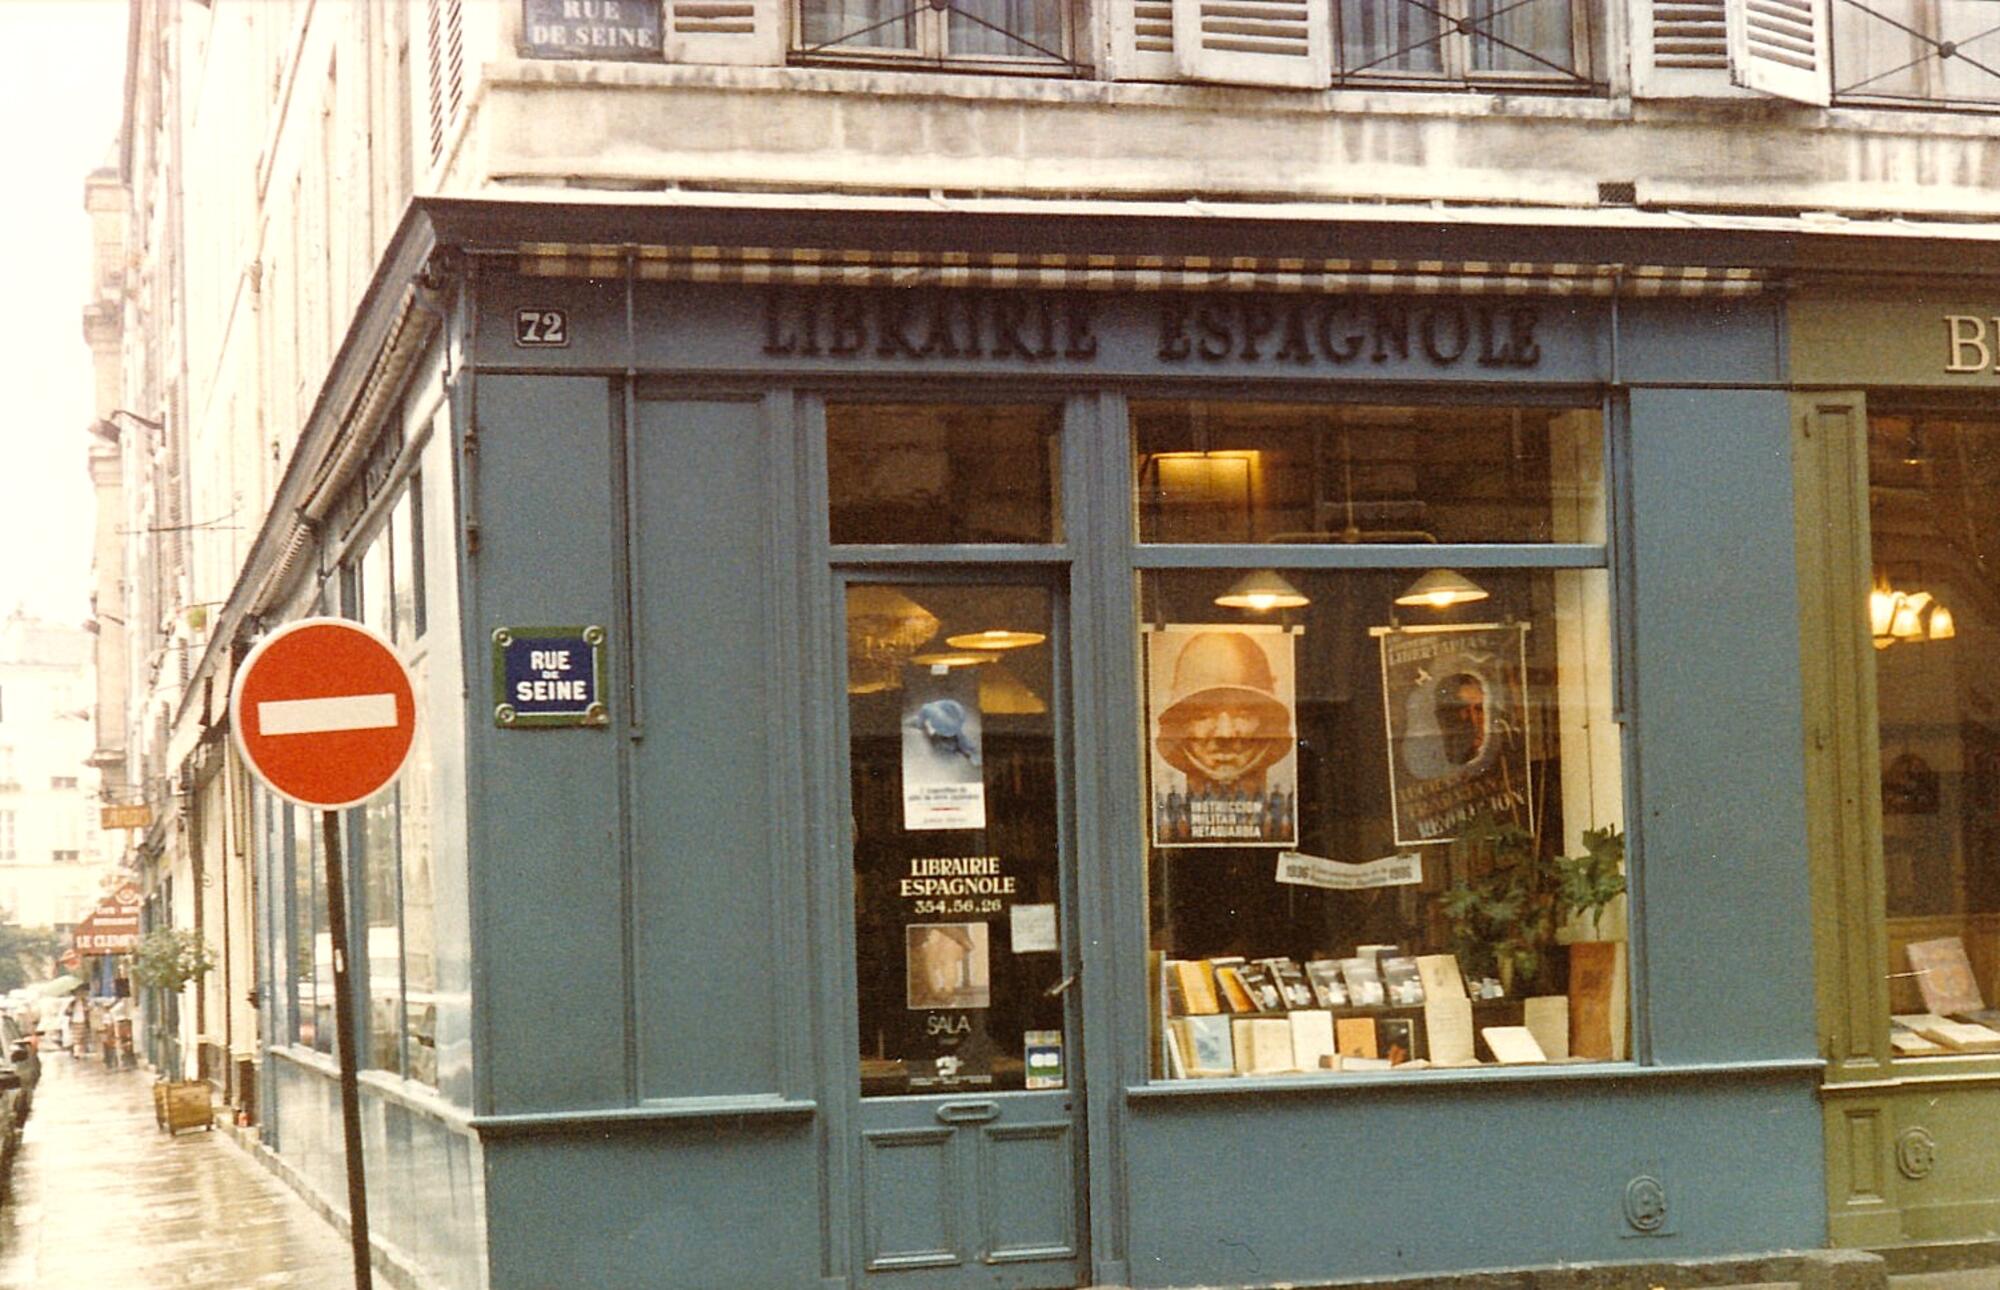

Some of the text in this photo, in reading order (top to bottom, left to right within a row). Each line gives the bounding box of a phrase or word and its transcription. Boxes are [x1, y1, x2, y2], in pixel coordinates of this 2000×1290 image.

[563, 0, 620, 20] RUE
[533, 25, 653, 48] DE SEINE
[520, 312, 563, 341] 72
[763, 289, 1541, 367] LIBRAIRIE ESPAGNOLE
[530, 650, 572, 670] RUE
[541, 670, 560, 679] DE
[516, 681, 587, 701] SEINE
[911, 857, 1001, 876] LIBRAIRIE
[900, 876, 1016, 897] ESPAGNOLE
[927, 1015, 971, 1035] SALA
